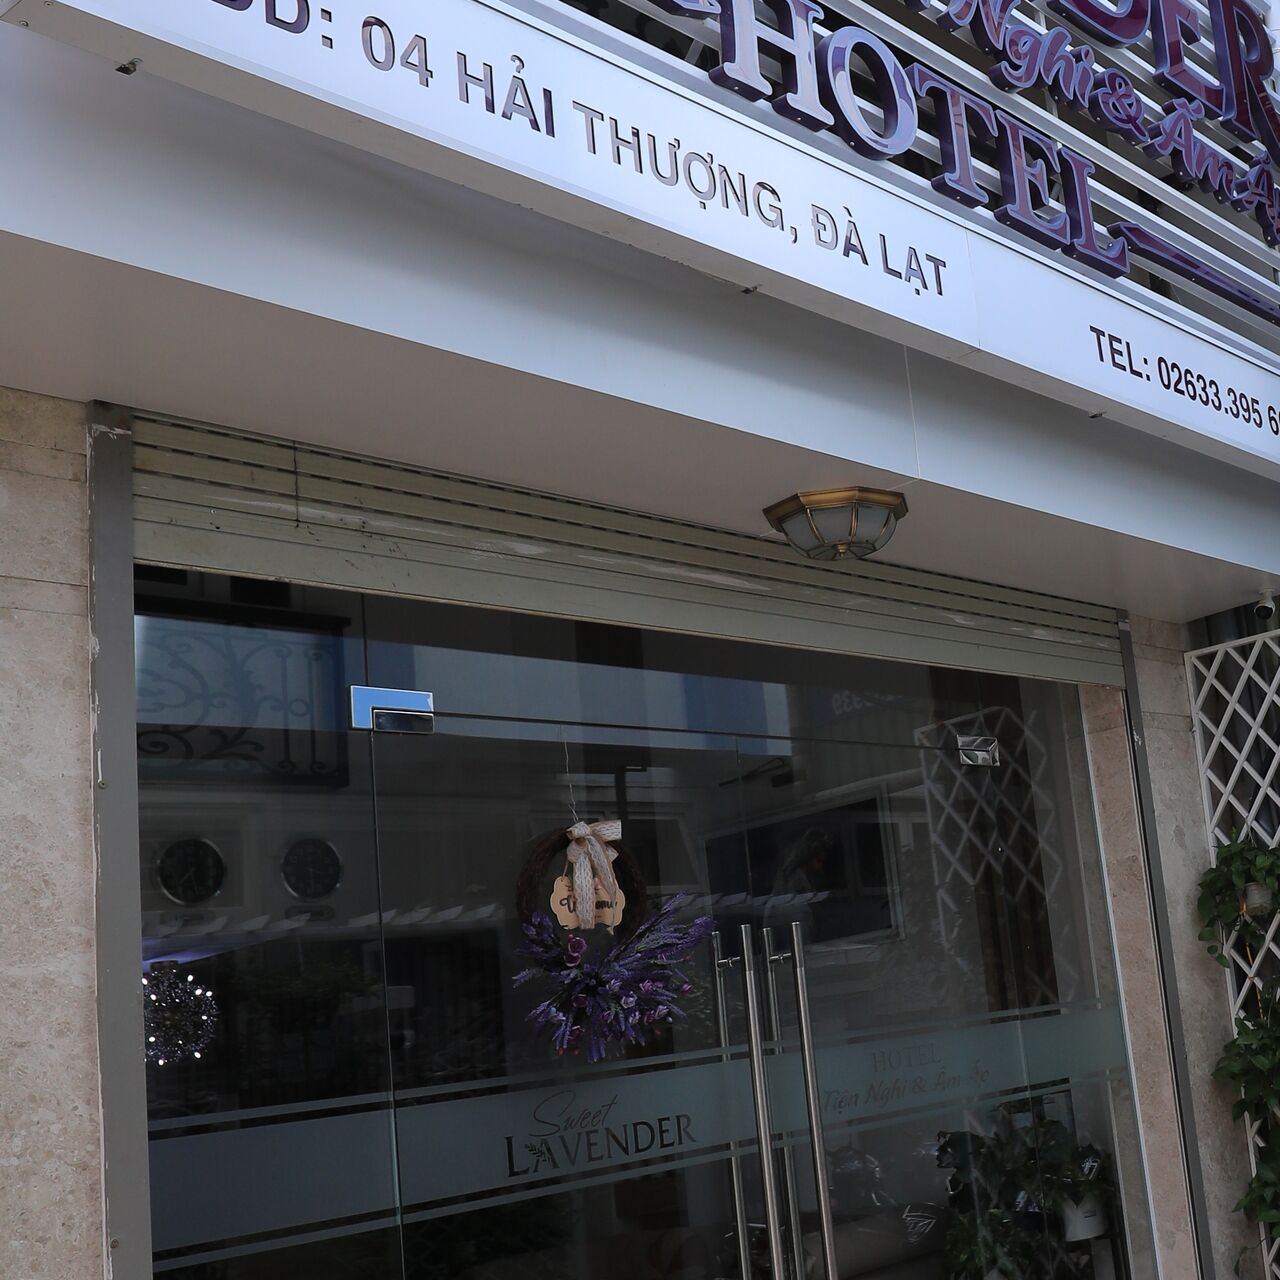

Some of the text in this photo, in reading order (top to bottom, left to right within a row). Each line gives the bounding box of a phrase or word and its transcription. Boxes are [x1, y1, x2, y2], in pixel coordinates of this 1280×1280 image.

[1090, 67, 1149, 148] &
[361, 15, 433, 88] 04
[456, 50, 556, 138] HẢI
[572, 100, 798, 244] THƯỢNG,
[811, 203, 869, 266] ĐÀ
[878, 232, 947, 297] LẠT
[1089, 324, 1152, 382] TEL:
[1157, 356, 1264, 429] 02633.395
[871, 1043, 942, 1073] HOTEL
[504, 1114, 696, 1178] LAVENDER
[528, 1090, 618, 1137] Sweet
